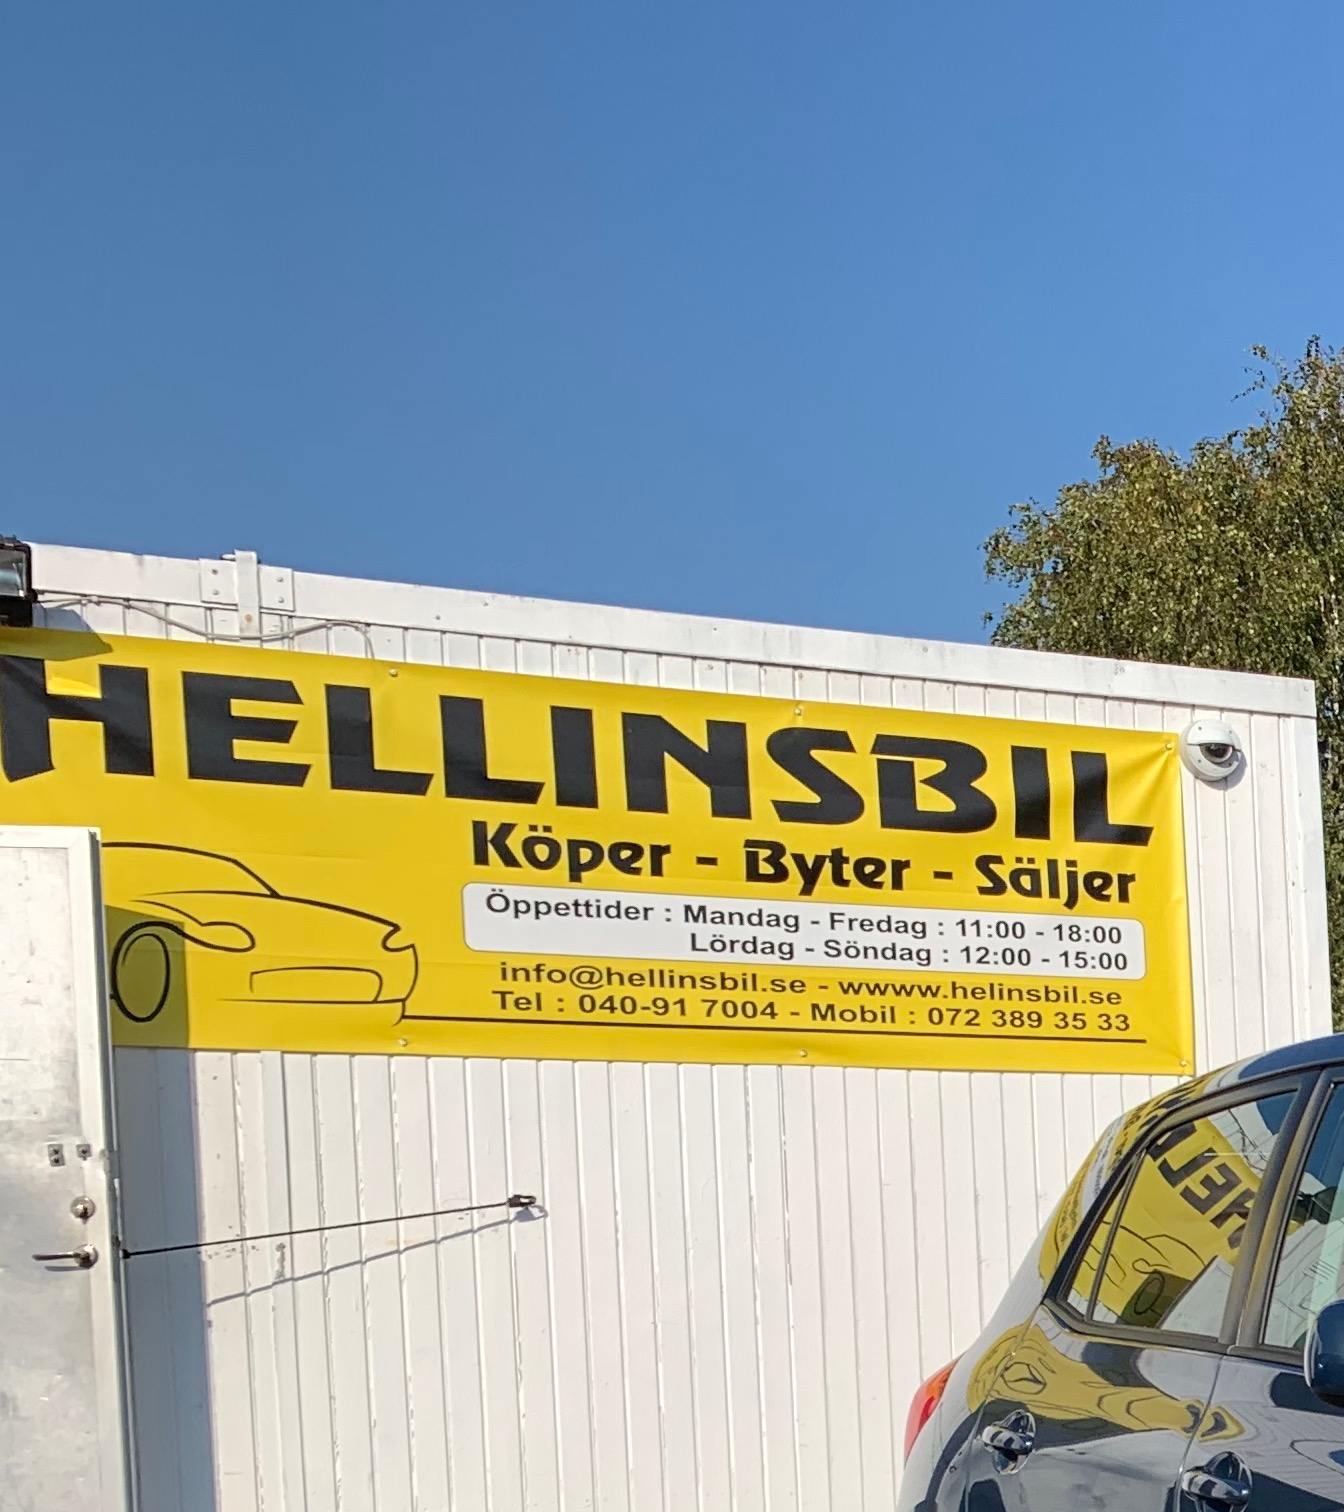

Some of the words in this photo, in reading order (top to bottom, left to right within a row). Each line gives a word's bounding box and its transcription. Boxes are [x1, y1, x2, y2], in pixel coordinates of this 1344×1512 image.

[0, 654, 1155, 847] HELLINSBIL
[471, 820, 671, 883] Köper
[743, 838, 911, 896] Byter
[974, 854, 1136, 910] Säljer
[485, 888, 655, 921] Öppettider
[683, 904, 800, 931] Mandag
[829, 911, 927, 939] Fredag
[955, 918, 1025, 939] 11:00
[1053, 924, 1121, 944] 18:00
[690, 932, 795, 960] Lördag
[823, 939, 931, 966] Söndag
[959, 945, 1031, 967] 12:00
[1060, 950, 1127, 970] 15:00
[500, 962, 807, 993] info@hellinsbil.se
[492, 990, 543, 1012] Tel
[578, 993, 687, 1016] 040-91
[700, 999, 778, 1019] 7004
[810, 1003, 896, 1024] Mobil
[928, 1007, 980, 1027] 072
[991, 1009, 1042, 1029] 389
[1054, 1011, 1086, 1030] 35
[1097, 1012, 1130, 1031] 33
